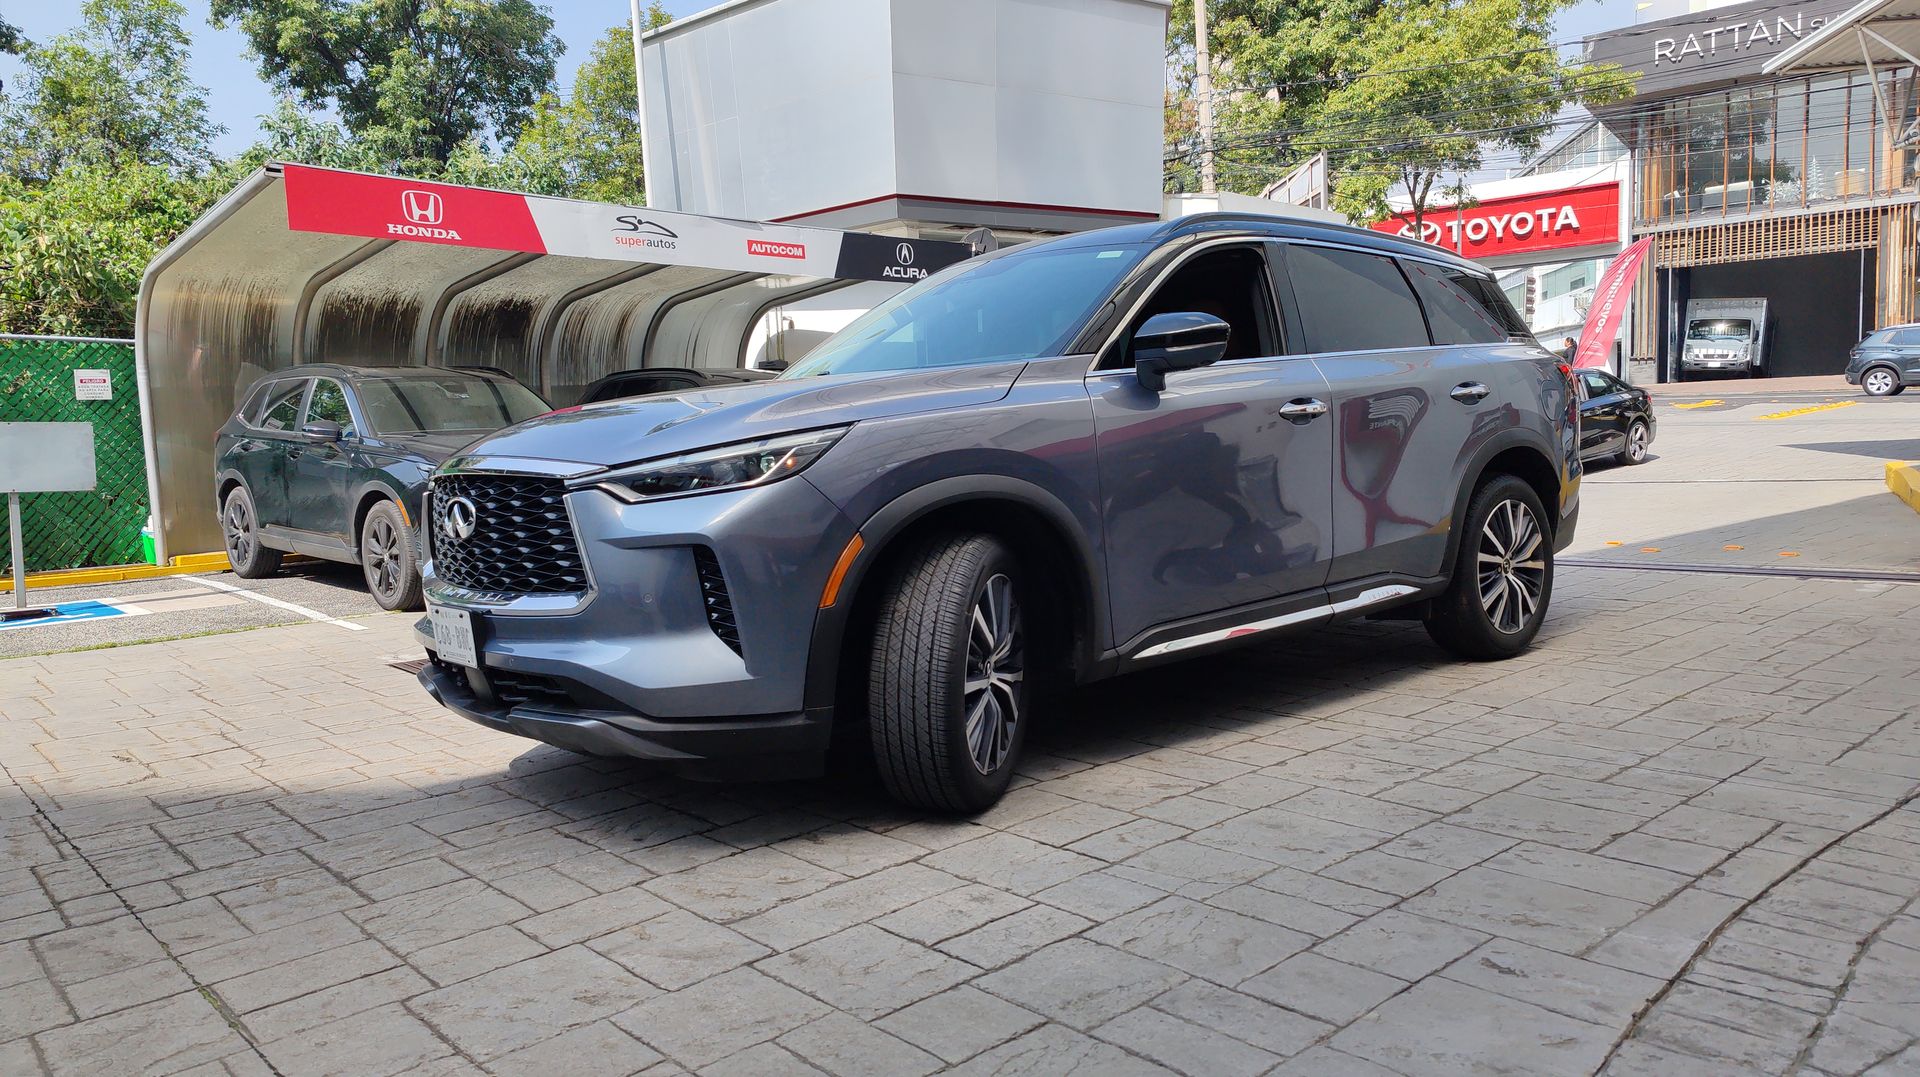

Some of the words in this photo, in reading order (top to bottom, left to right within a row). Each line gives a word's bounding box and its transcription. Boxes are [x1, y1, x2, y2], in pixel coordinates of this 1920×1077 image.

[1655, 12, 1802, 65] RATTAN
[386, 223, 462, 240] HONDA
[1446, 205, 1580, 243] TOYOTA
[615, 236, 677, 250] superautos
[751, 243, 803, 257] AUTOCOM
[882, 266, 928, 280] ACURA
